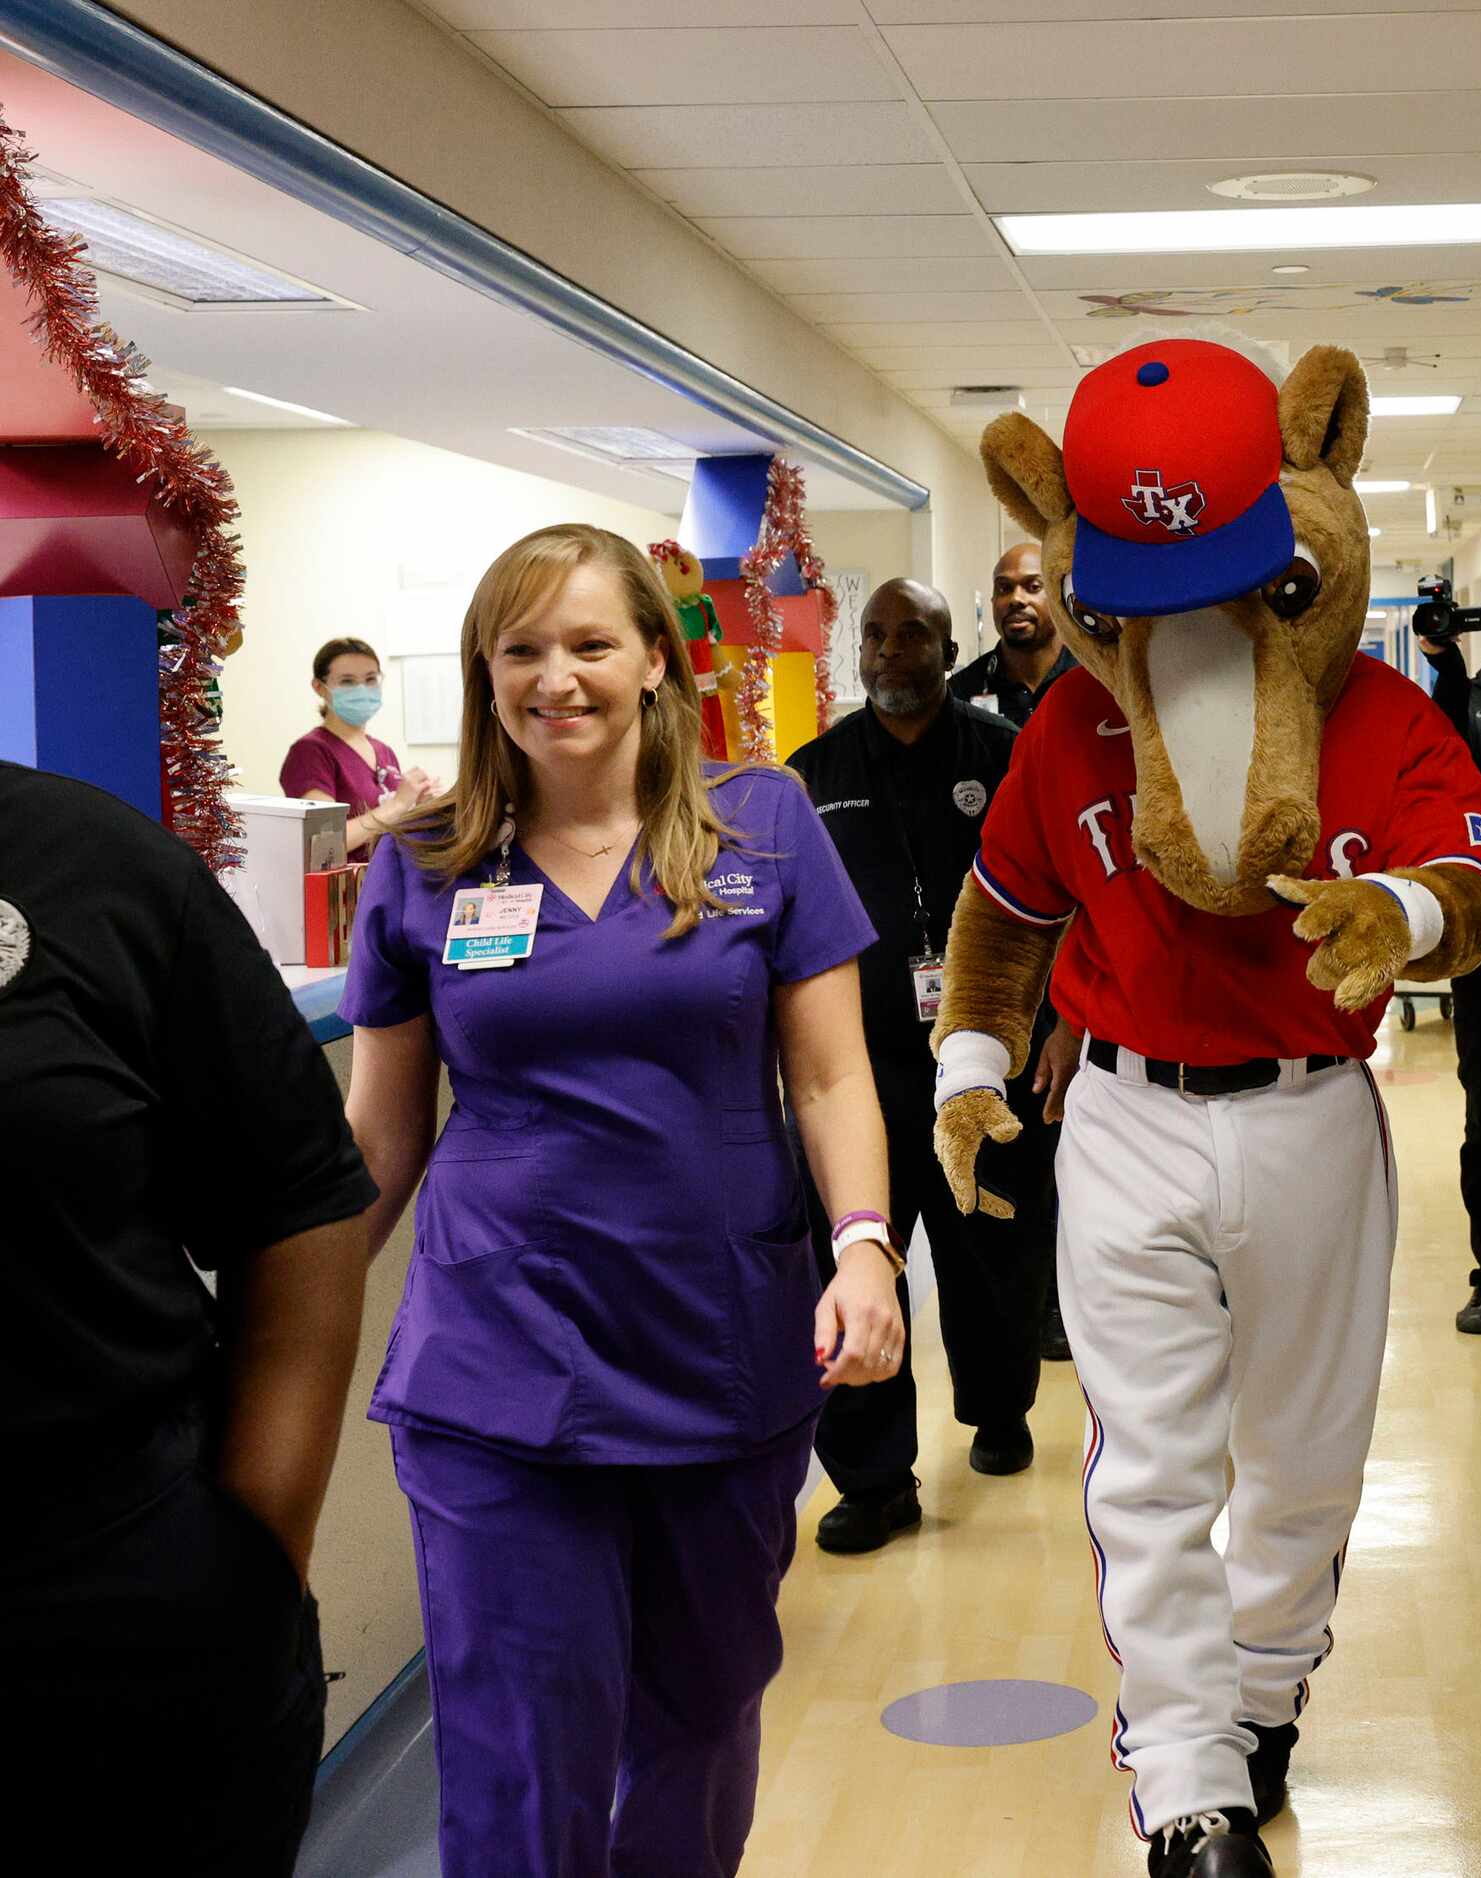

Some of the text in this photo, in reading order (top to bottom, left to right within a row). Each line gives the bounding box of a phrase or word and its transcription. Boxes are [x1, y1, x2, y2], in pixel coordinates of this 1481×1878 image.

[1131, 485, 1199, 531] TX
[816, 799, 870, 815] SECURITY OFFICER
[727, 873, 753, 887] City
[720, 886, 754, 896] Hospital
[728, 906, 765, 916] Services
[466, 935, 513, 948] Child Life
[465, 946, 510, 959] Specialist
